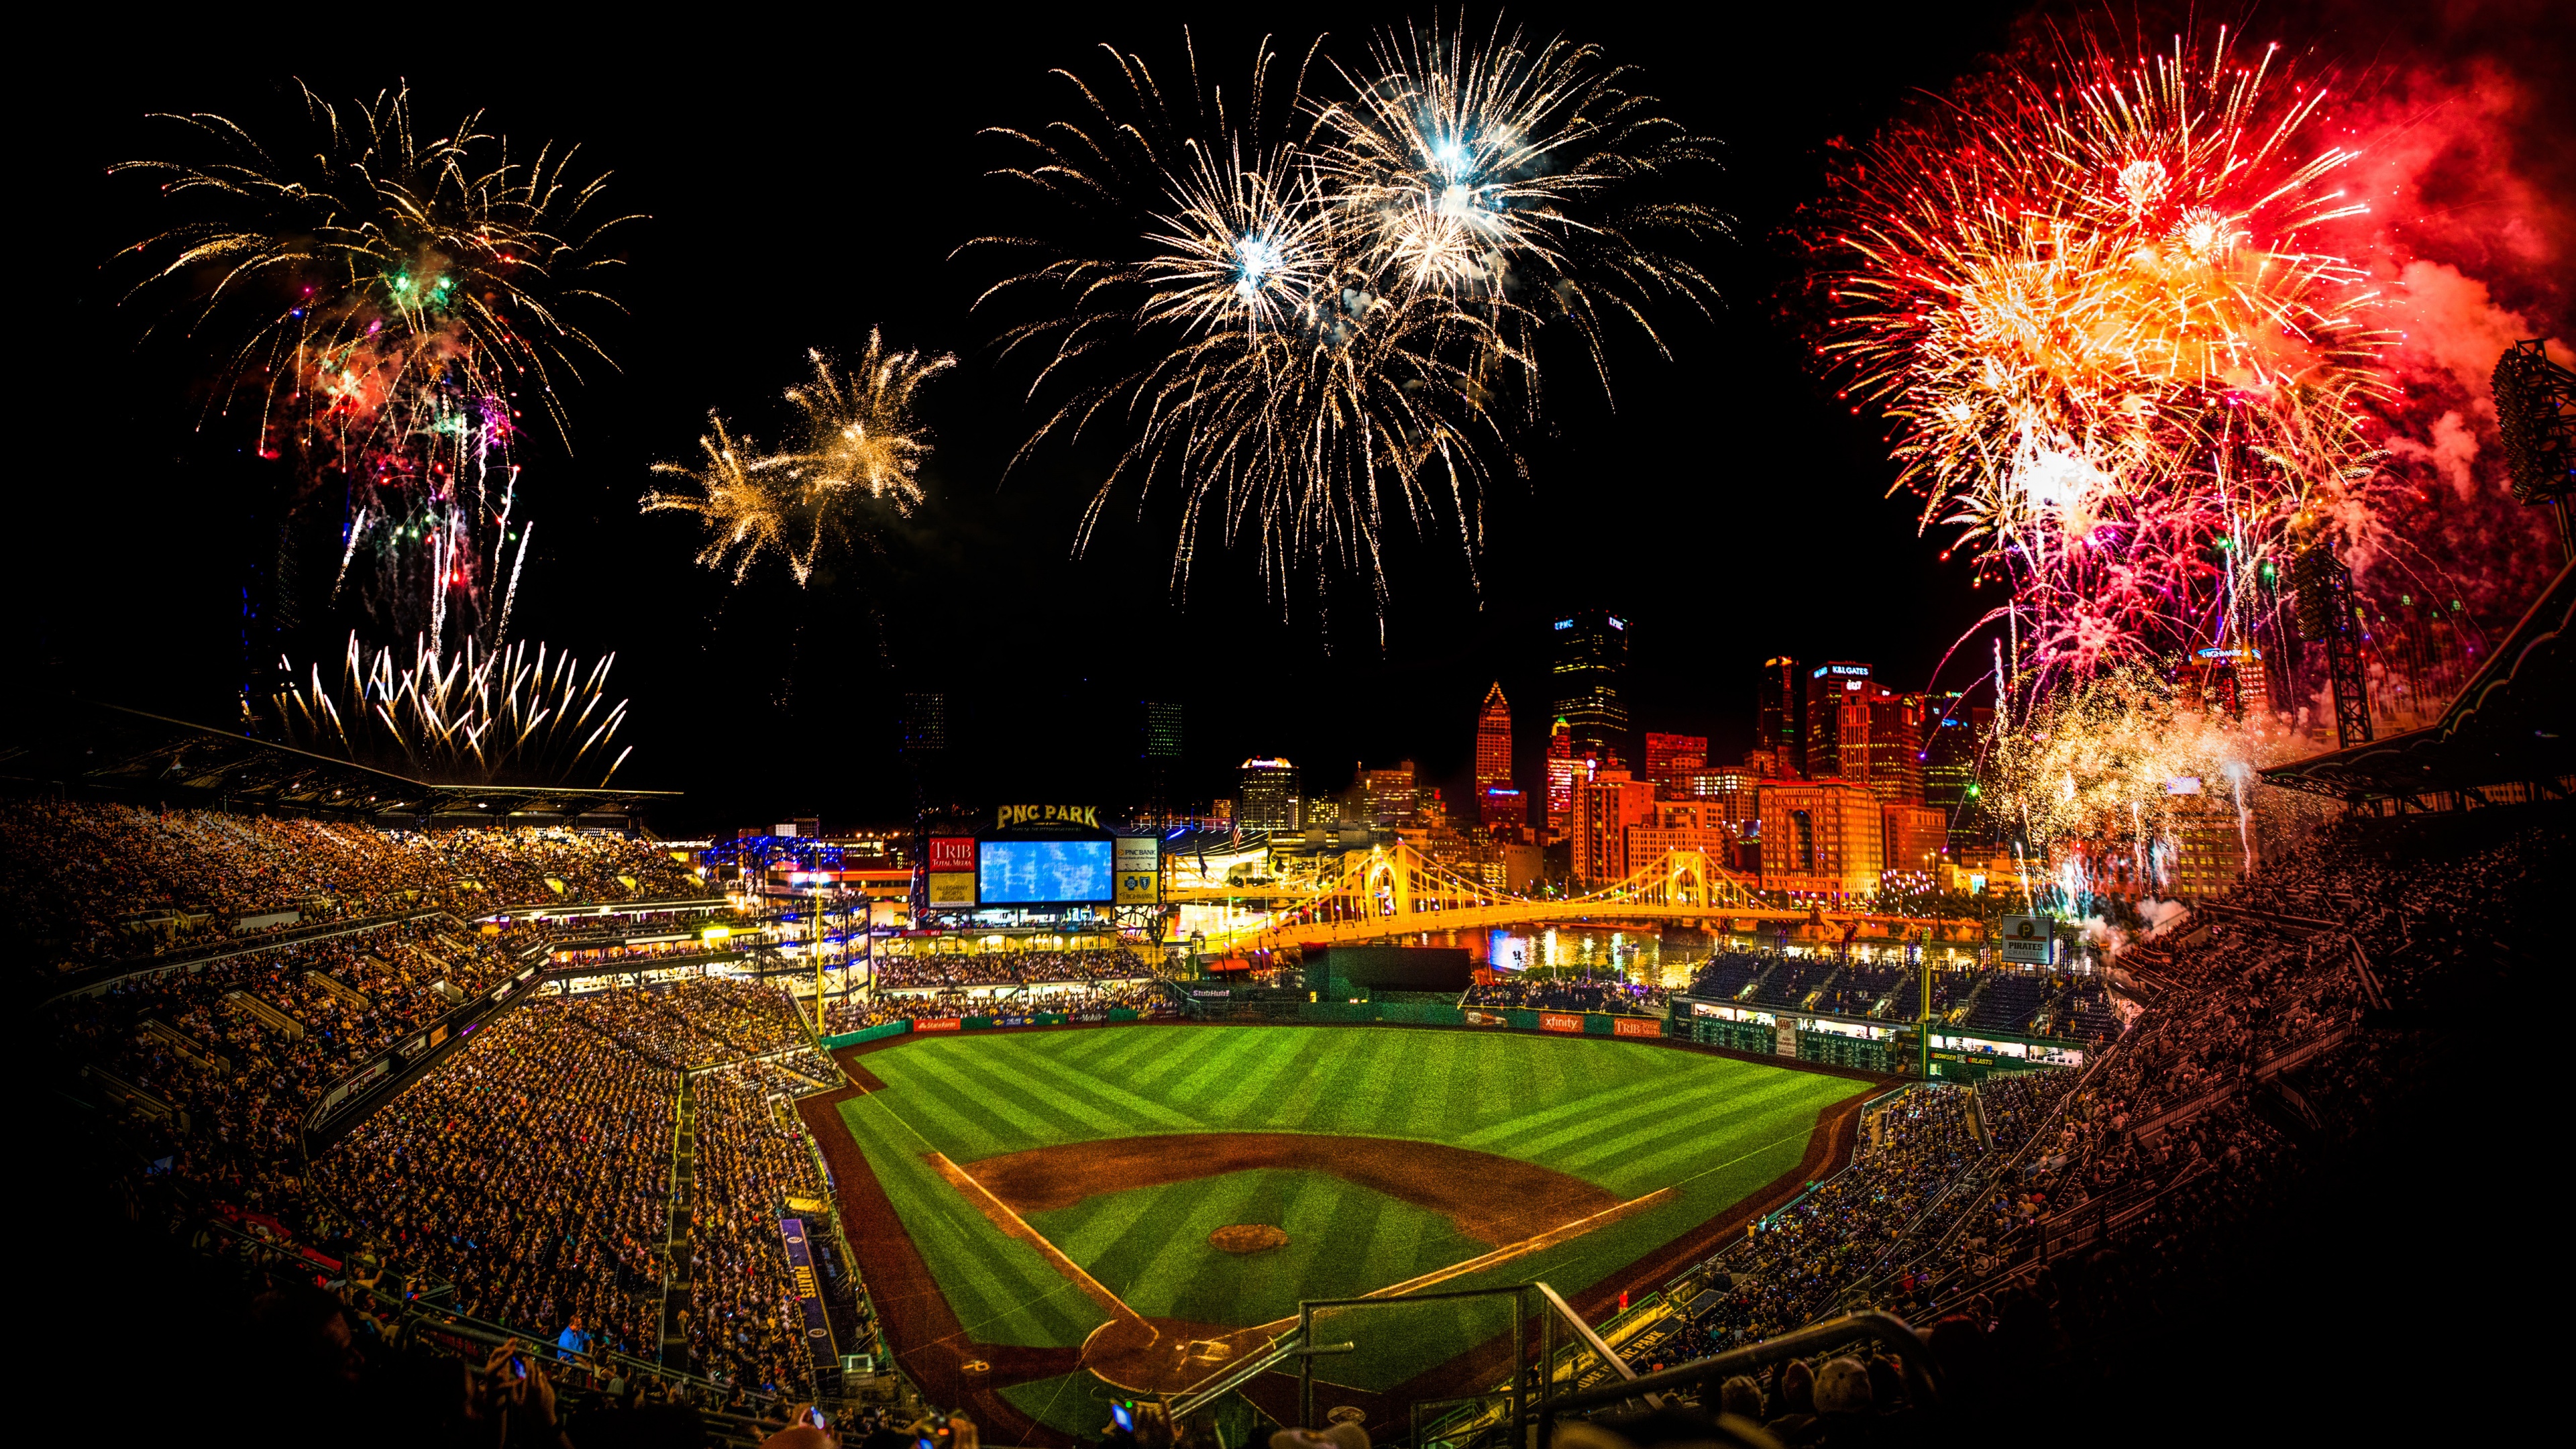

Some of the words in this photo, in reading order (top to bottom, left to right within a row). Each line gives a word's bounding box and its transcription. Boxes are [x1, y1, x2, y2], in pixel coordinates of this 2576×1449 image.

[1845, 667, 1869, 676] GATES
[996, 804, 1040, 830] PNC
[1044, 804, 1100, 830] PARK
[931, 841, 972, 859] TRIB
[2008, 942, 2043, 951] PIRATES
[1546, 1016, 1578, 1029] xfinity
[1615, 1022, 1640, 1034] TRIB
[1699, 1020, 1735, 1030] NATIONAL
[1736, 1026, 1765, 1034] LEAGUE
[1807, 1036, 1849, 1047] AMERICAN
[1851, 1042, 1884, 1051] LEAGUE
[1933, 1053, 1957, 1061] BOWSER
[1972, 1057, 1993, 1065] BLASTS
[794, 1265, 816, 1298] PIRATES
[1631, 1330, 1666, 1350] PARK
